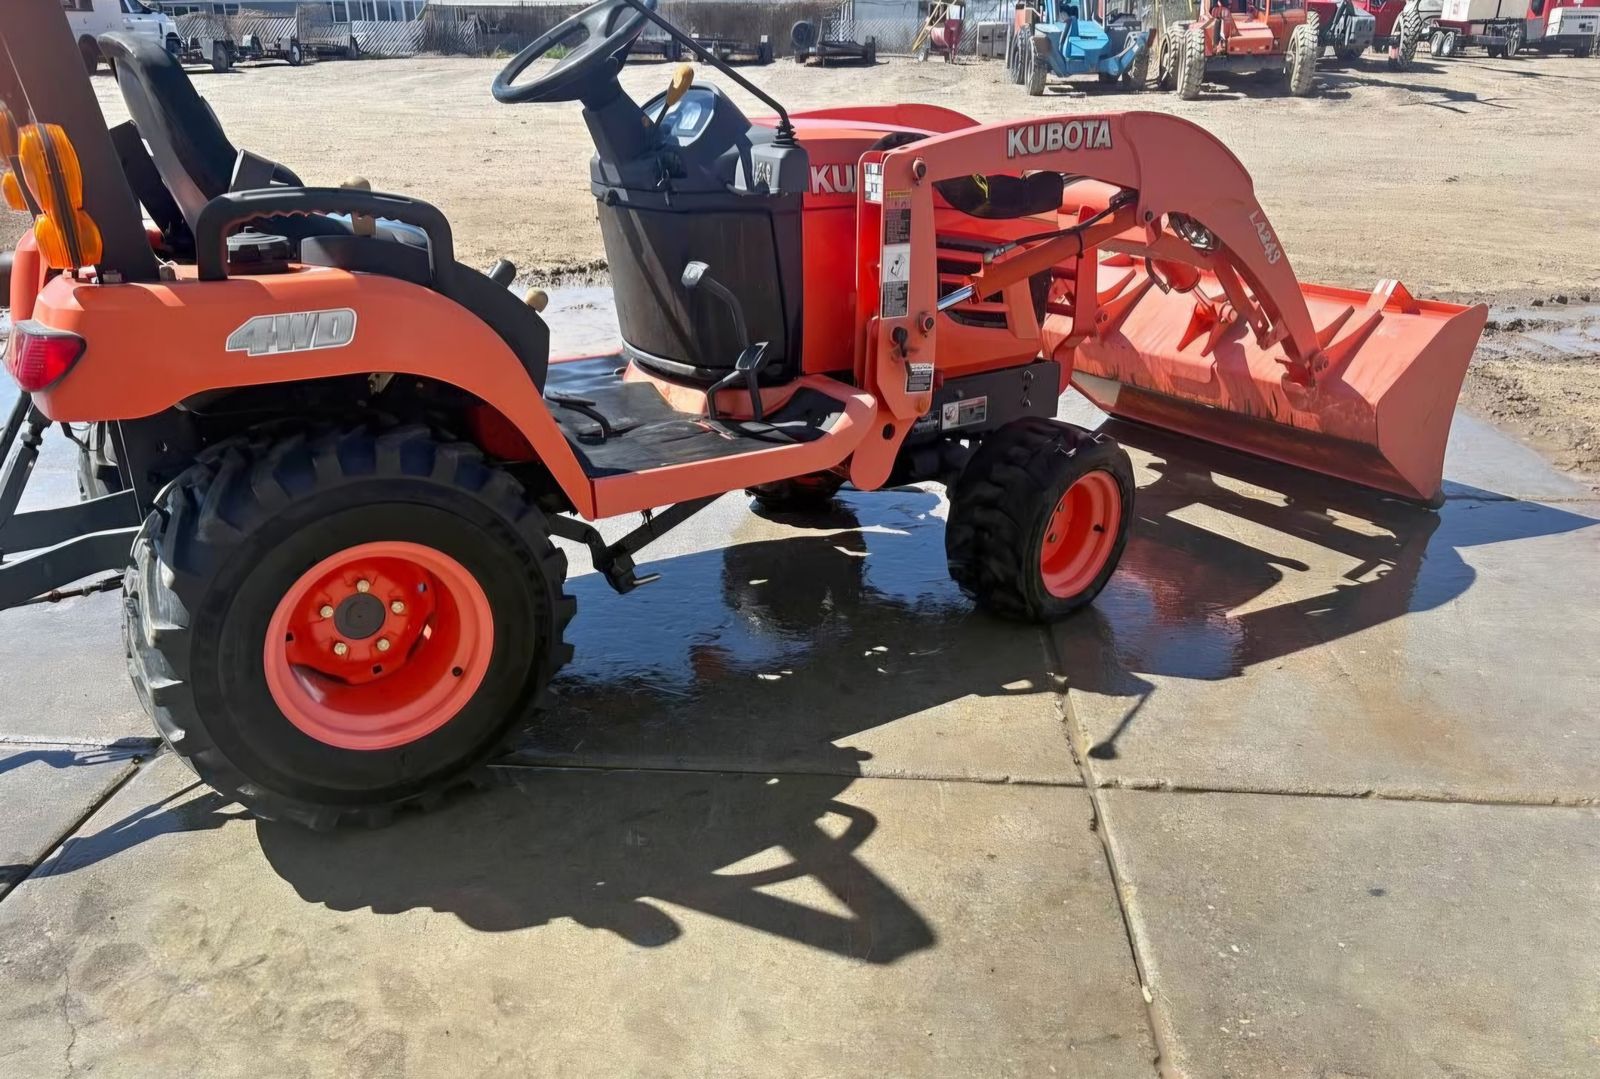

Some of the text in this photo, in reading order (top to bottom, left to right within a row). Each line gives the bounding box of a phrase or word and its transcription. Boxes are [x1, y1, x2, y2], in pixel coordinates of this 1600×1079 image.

[1007, 120, 1112, 158] KUBOTA
[810, 163, 857, 194] KU
[226, 308, 356, 356] 4WD
